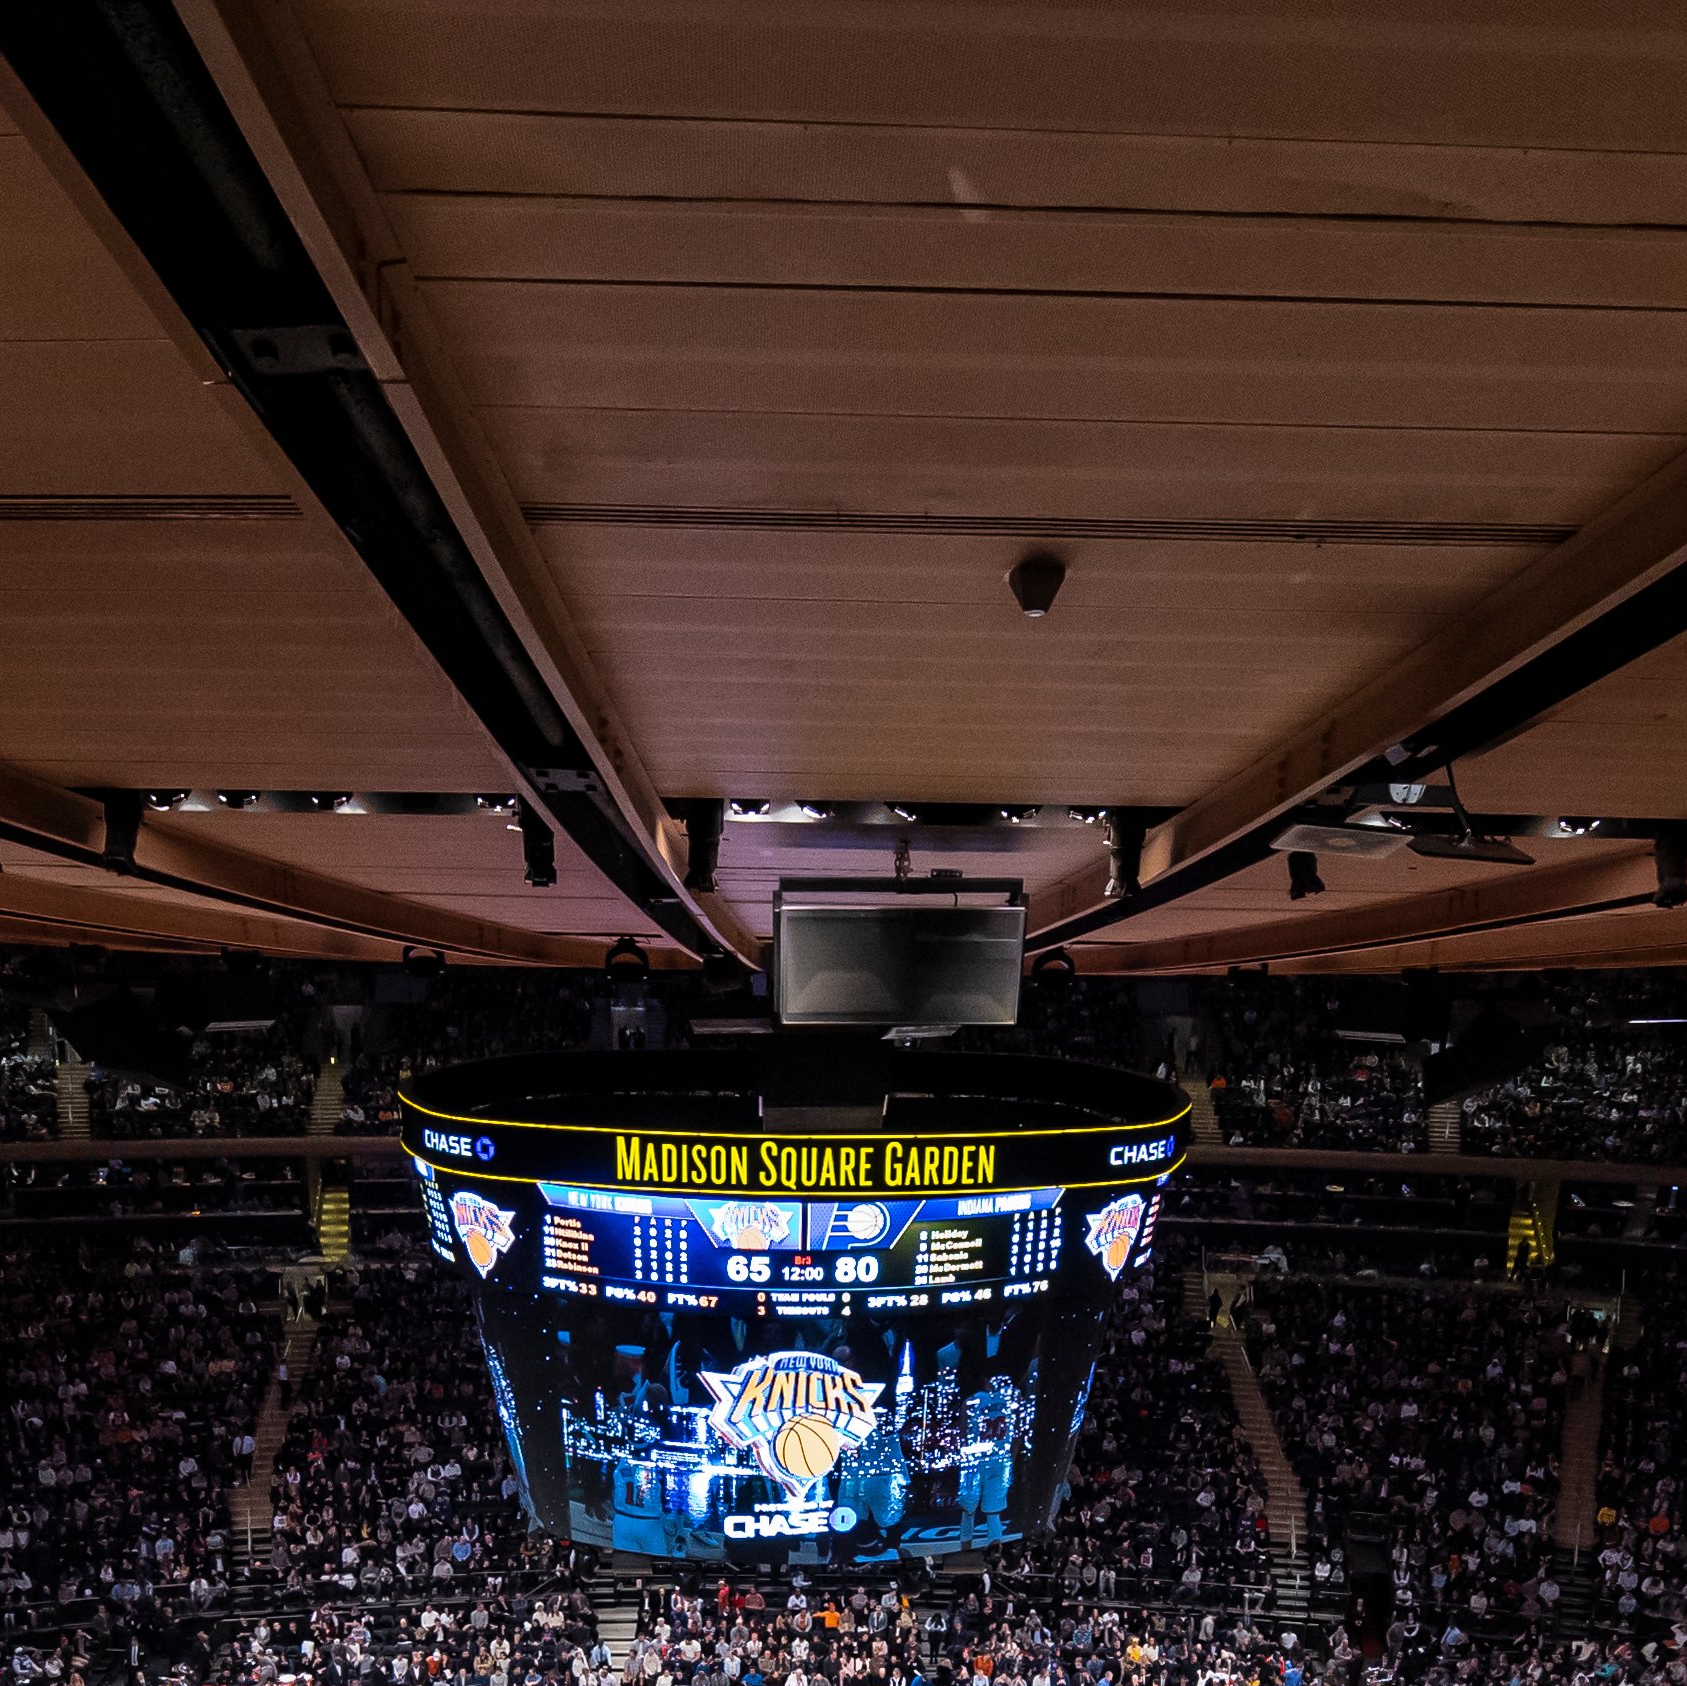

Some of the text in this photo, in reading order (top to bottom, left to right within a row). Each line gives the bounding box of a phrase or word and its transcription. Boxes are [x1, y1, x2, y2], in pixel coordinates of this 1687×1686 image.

[424, 1128, 472, 1156] CHASE
[1110, 1139, 1166, 1165] CHASE
[616, 1136, 995, 1188] MADISON SQUARE GARDEN
[727, 1255, 879, 1283] 65 12:00 80
[579, 1283, 597, 1296] 33
[637, 1291, 656, 1303] 40
[757, 1293, 766, 1302] 0
[698, 1296, 718, 1308] 67
[757, 1306, 766, 1316] 3
[841, 1306, 851, 1316] 4
[780, 1357, 808, 1369] NEW
[730, 1367, 872, 1423] KNICKS
[724, 1511, 830, 1538] CHASE
